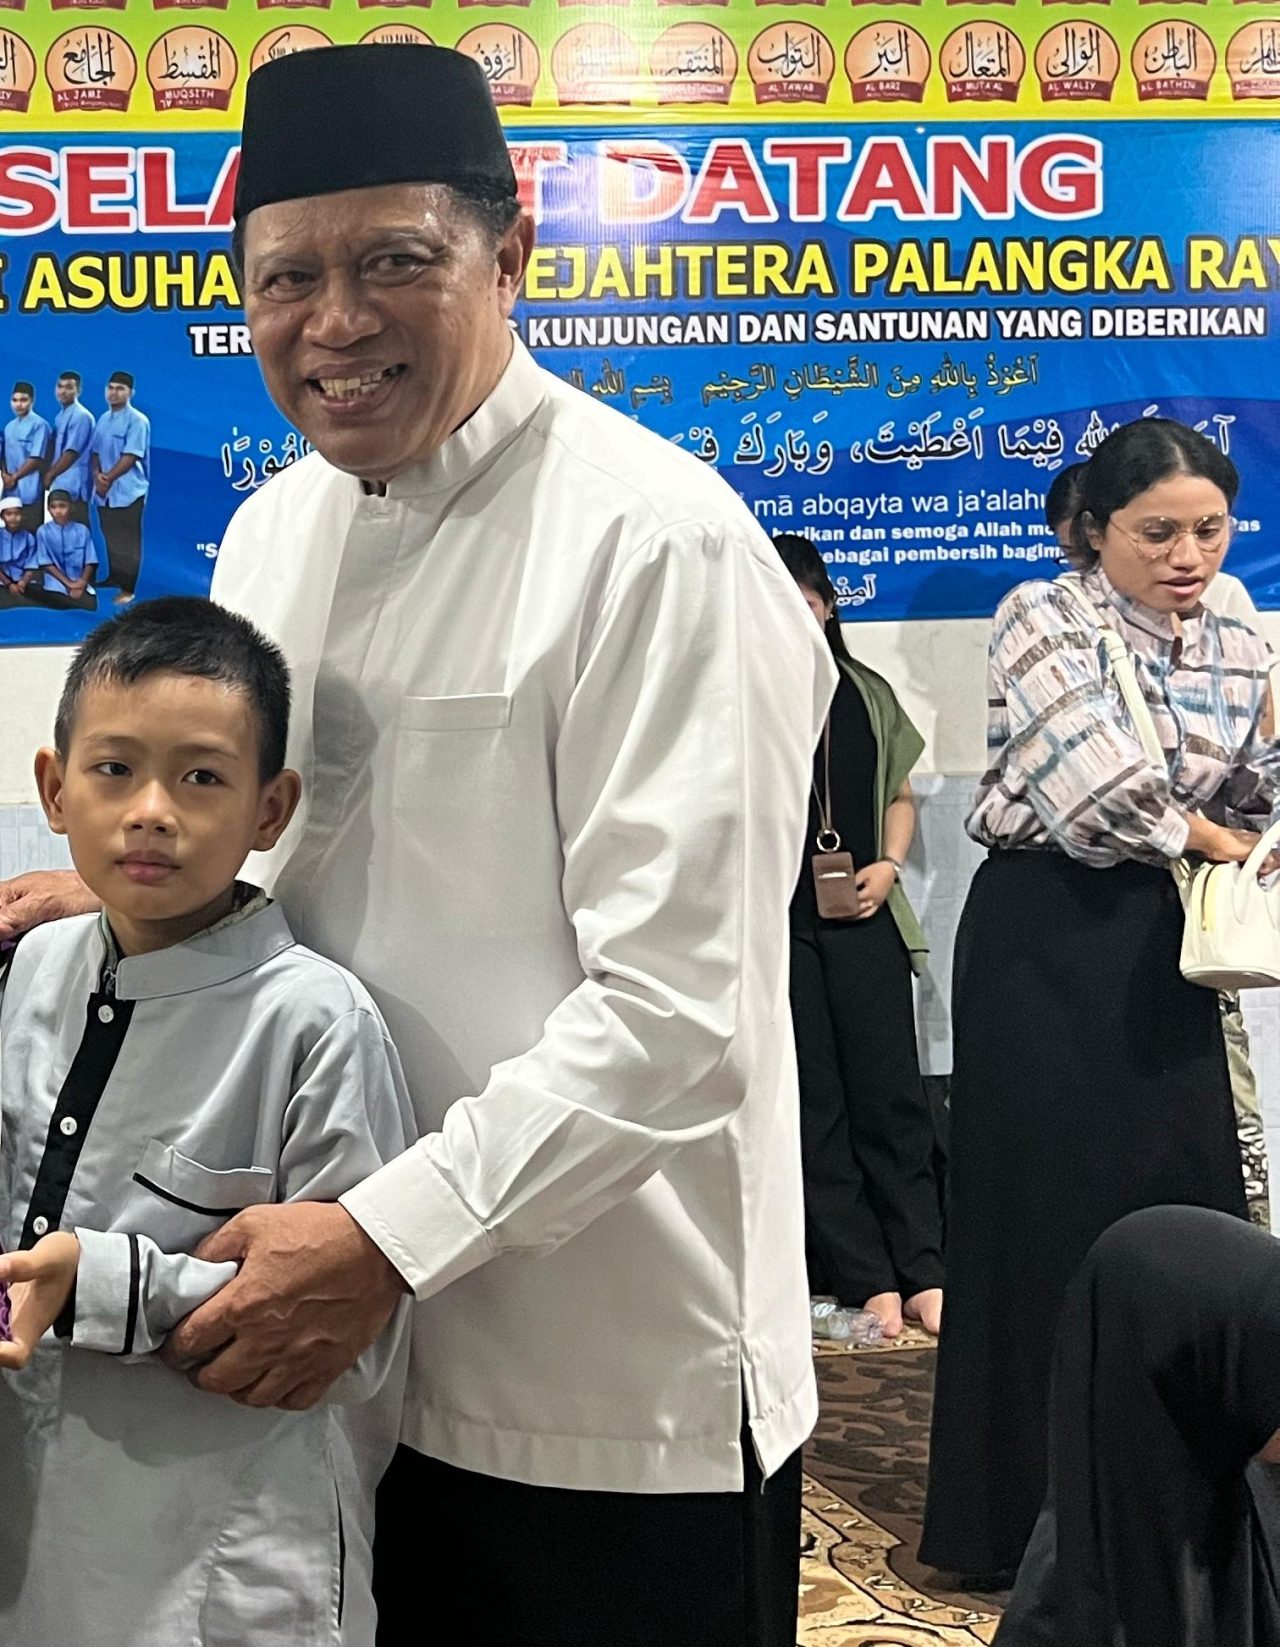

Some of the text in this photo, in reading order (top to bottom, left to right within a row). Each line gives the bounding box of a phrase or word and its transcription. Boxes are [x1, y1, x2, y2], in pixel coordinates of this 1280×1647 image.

[57, 92, 69, 102] AL
[600, 134, 1103, 223] DATANG
[23, 254, 241, 310] ASUHA
[524, 243, 835, 300] EJAHTERA
[853, 240, 1171, 294] PALANGKA
[528, 314, 728, 347] KUNJUNGAN
[739, 313, 807, 343] DAN
[814, 310, 988, 342] SANTUNAN
[996, 308, 1083, 338] YANG
[1092, 306, 1265, 337] DIBERIKAN
[802, 493, 904, 520] abqayta
[911, 496, 949, 514] wa
[849, 525, 886, 540] dan
[891, 527, 968, 543] semoga
[974, 521, 1022, 537] Allah
[821, 547, 889, 566] ebagai
[894, 544, 998, 565] pembersih
